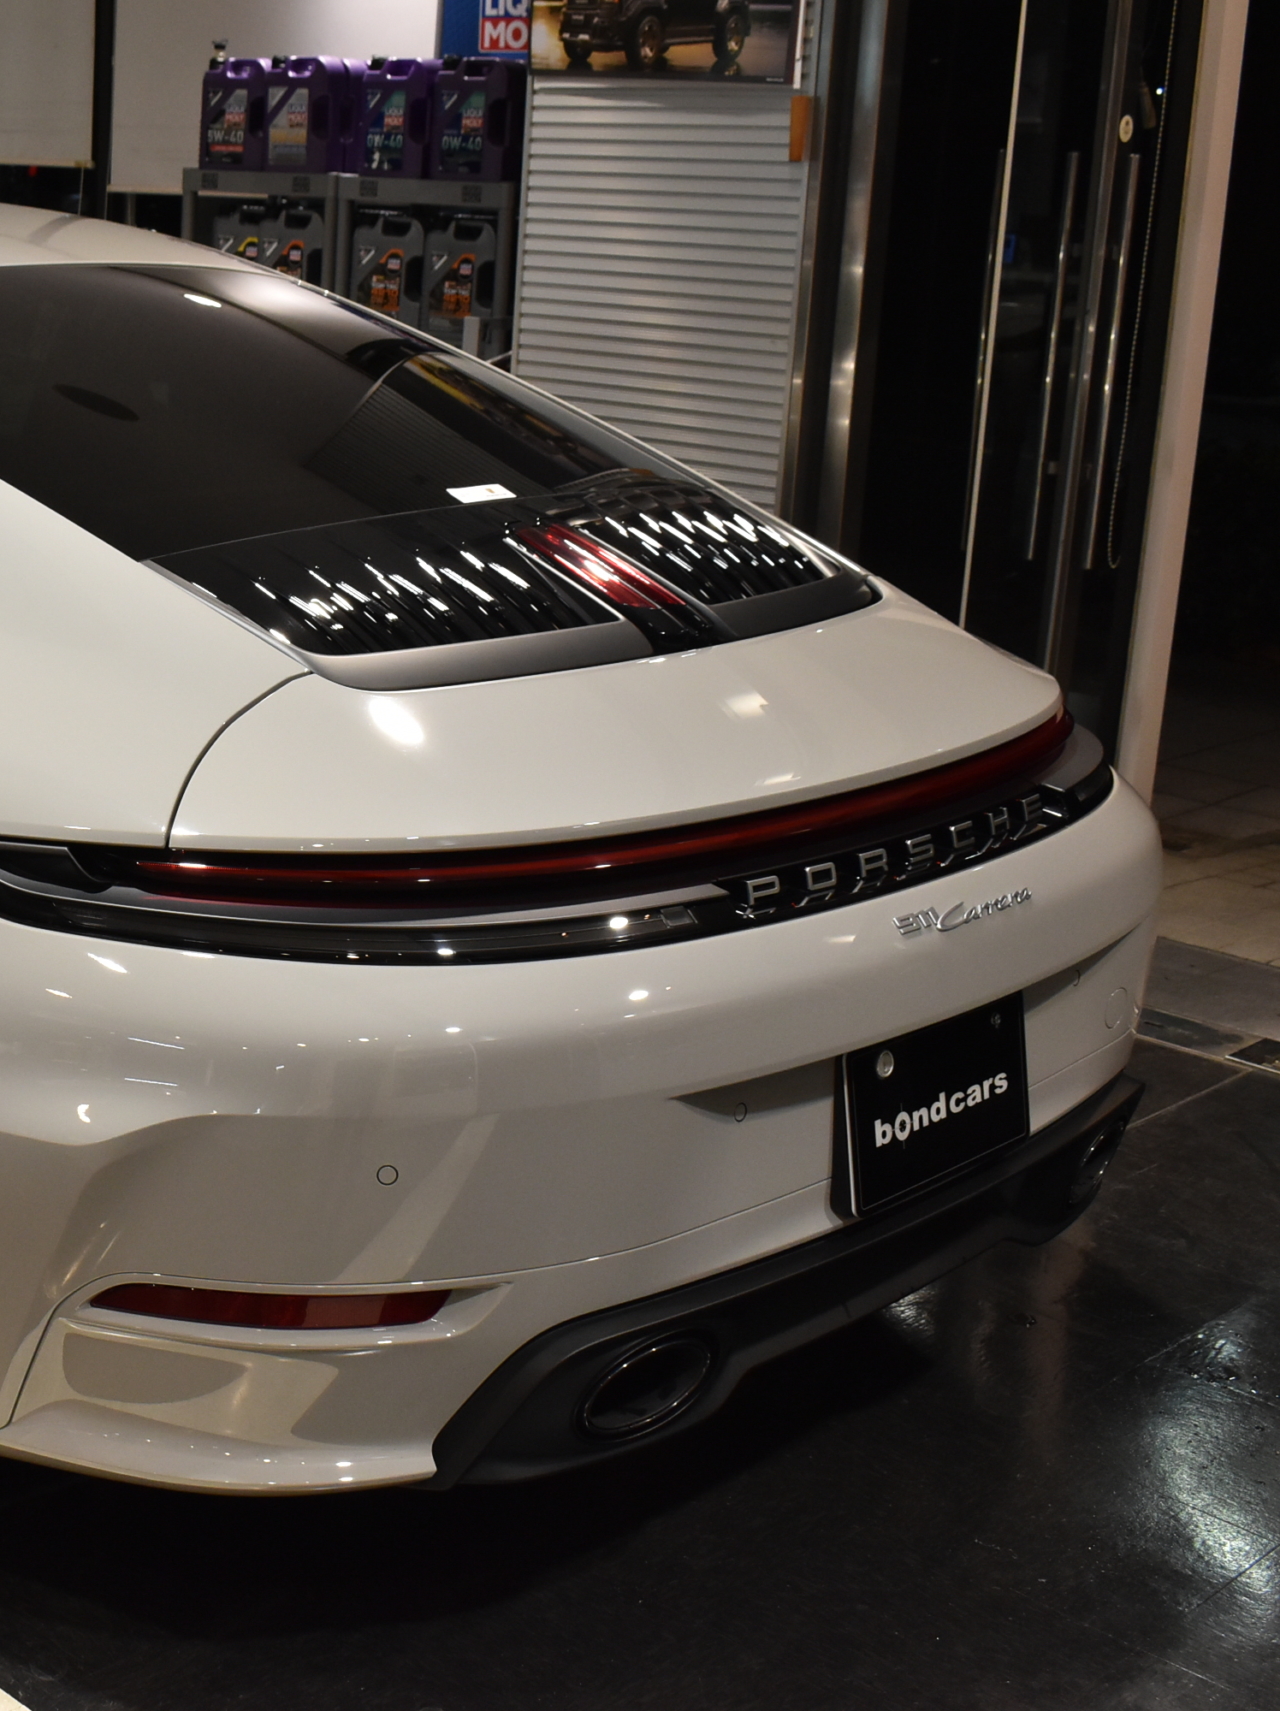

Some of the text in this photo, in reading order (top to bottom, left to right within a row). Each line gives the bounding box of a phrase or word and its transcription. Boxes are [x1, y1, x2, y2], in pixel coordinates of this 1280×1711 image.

[484, 0, 529, 17] LIQ
[483, 20, 528, 49] MO
[207, 129, 245, 143] 5W-40
[366, 133, 404, 148] 0W-40
[441, 135, 483, 150] 0W-40
[745, 793, 1043, 905] PORSCHE
[892, 887, 1032, 935] 911 Carrera
